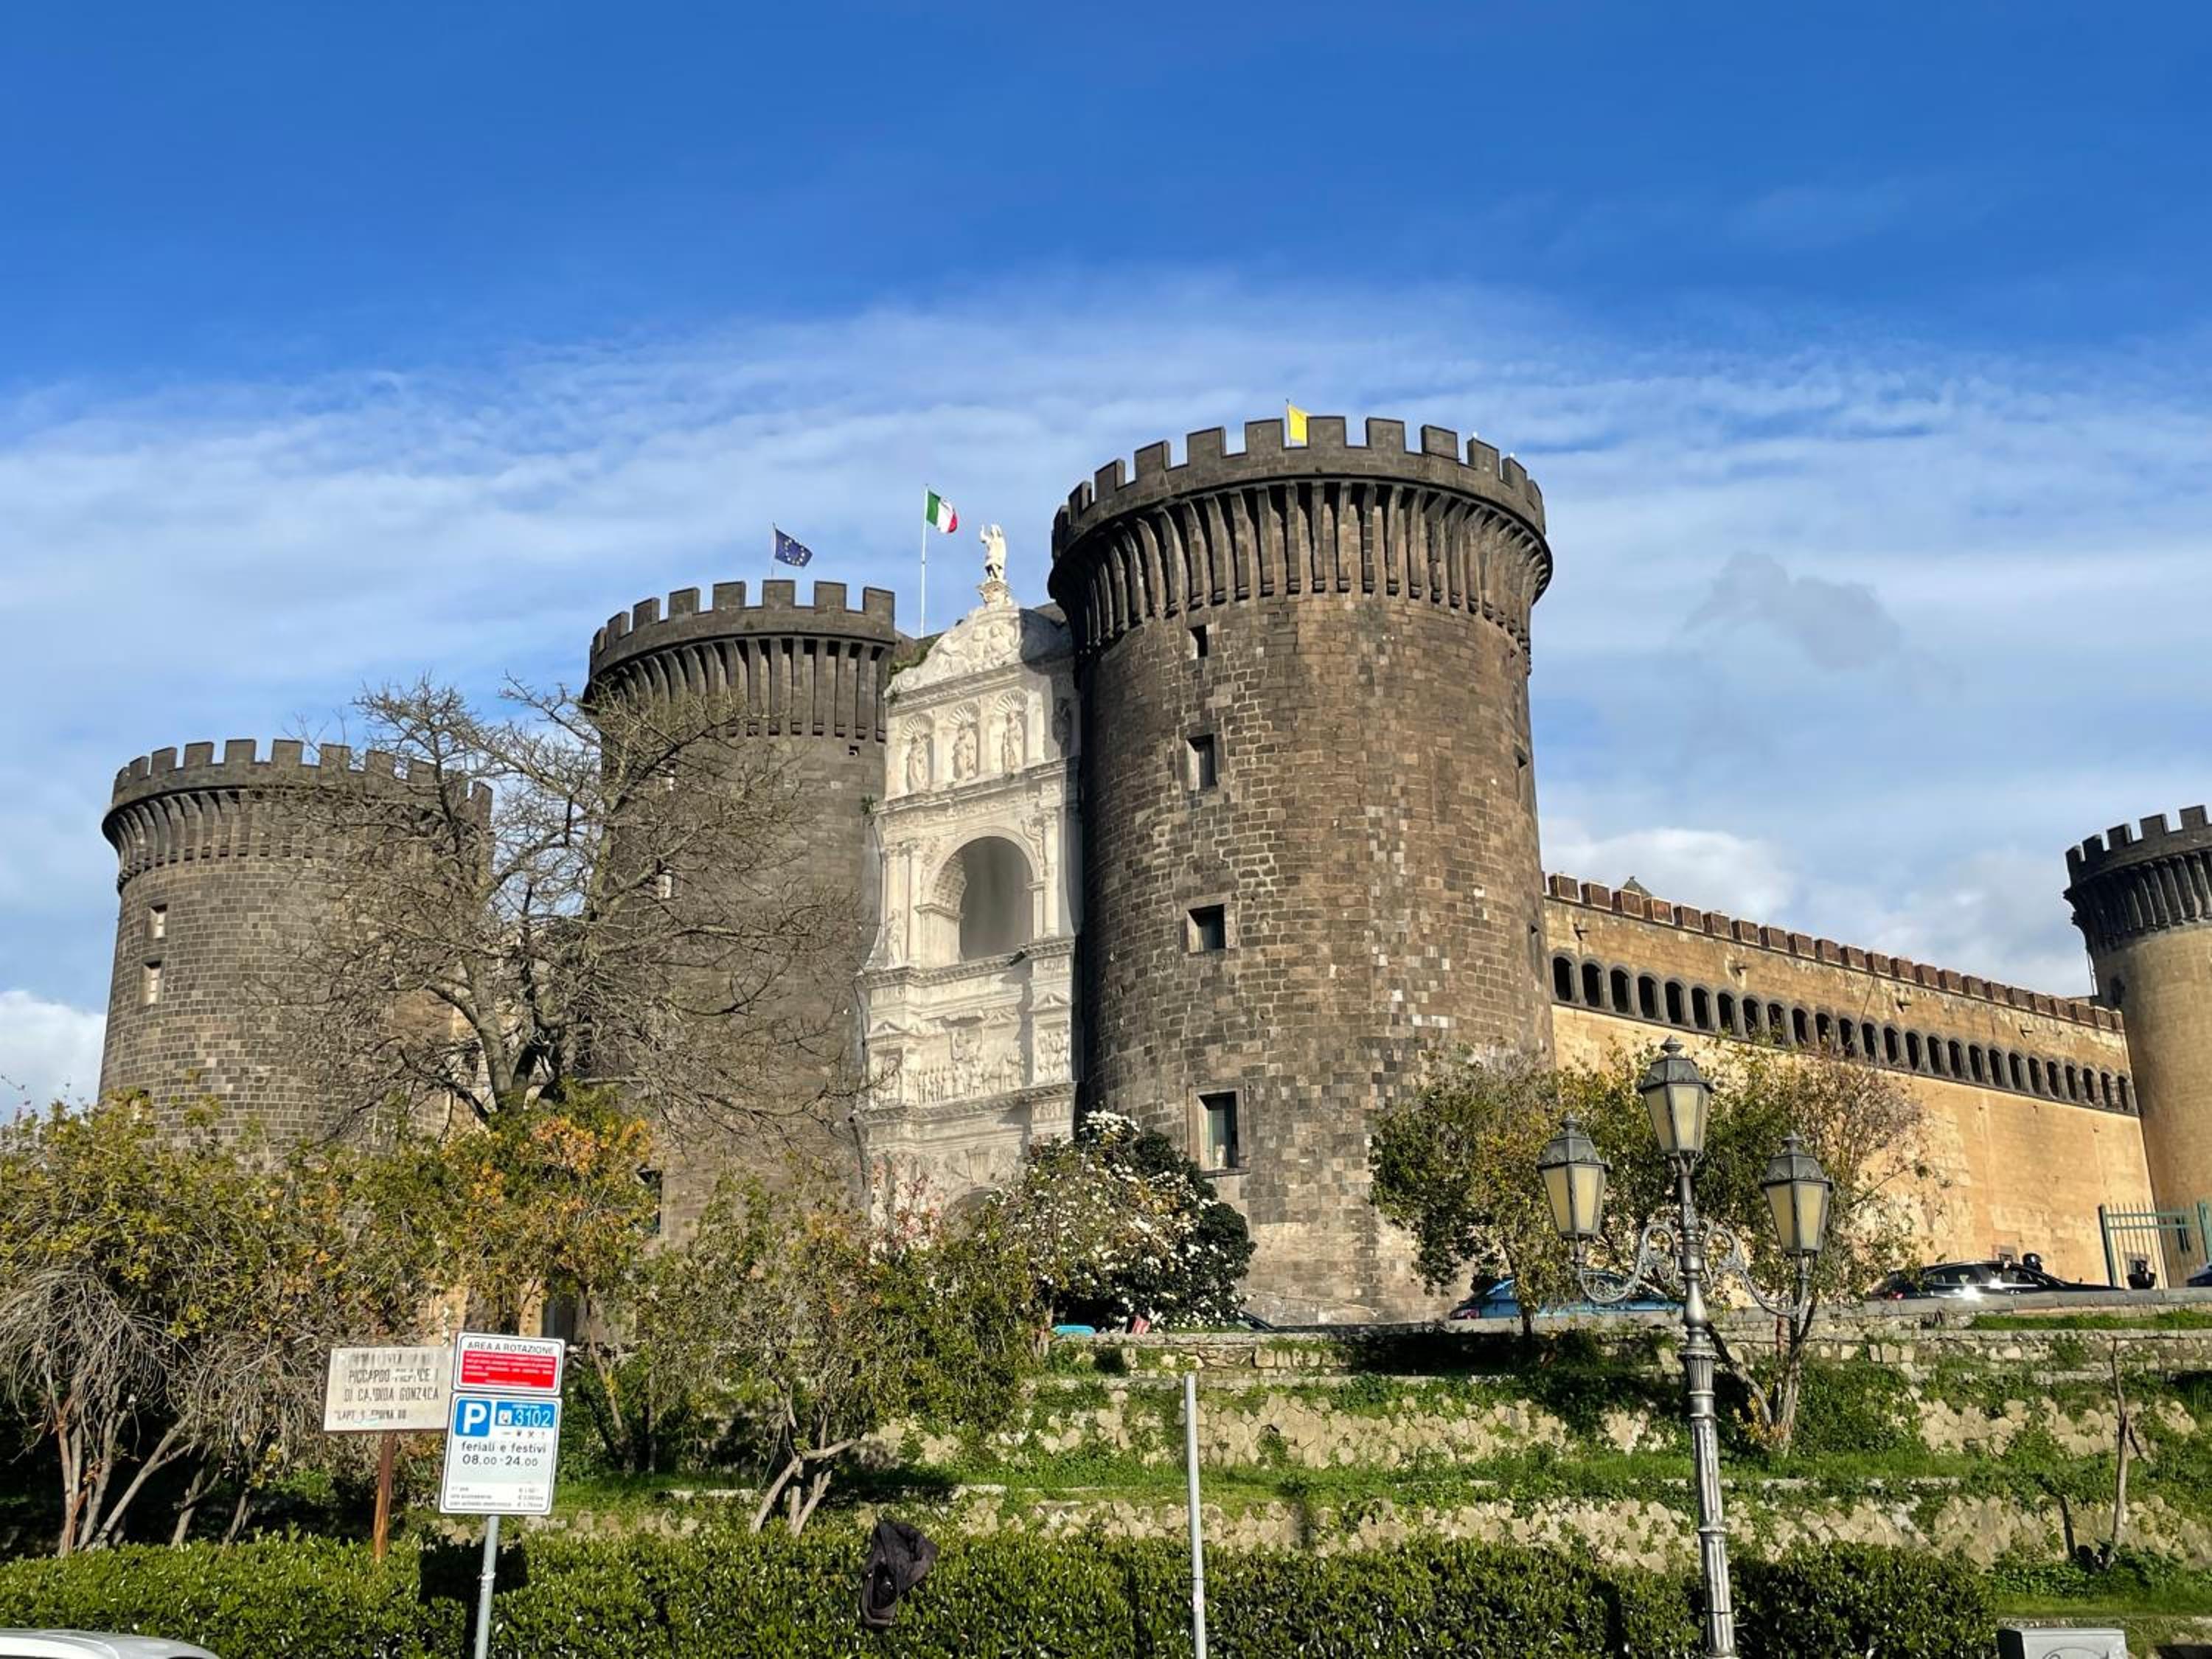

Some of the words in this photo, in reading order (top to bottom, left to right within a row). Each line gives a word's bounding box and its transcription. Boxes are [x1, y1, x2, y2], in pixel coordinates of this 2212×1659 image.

[467, 1340, 492, 1350] AREA
[495, 1342, 501, 1350] A
[504, 1343, 554, 1354] ROTAZIONE
[515, 1410, 551, 1427] 3102
[461, 1441, 495, 1452] feriali
[511, 1443, 546, 1453] festivi
